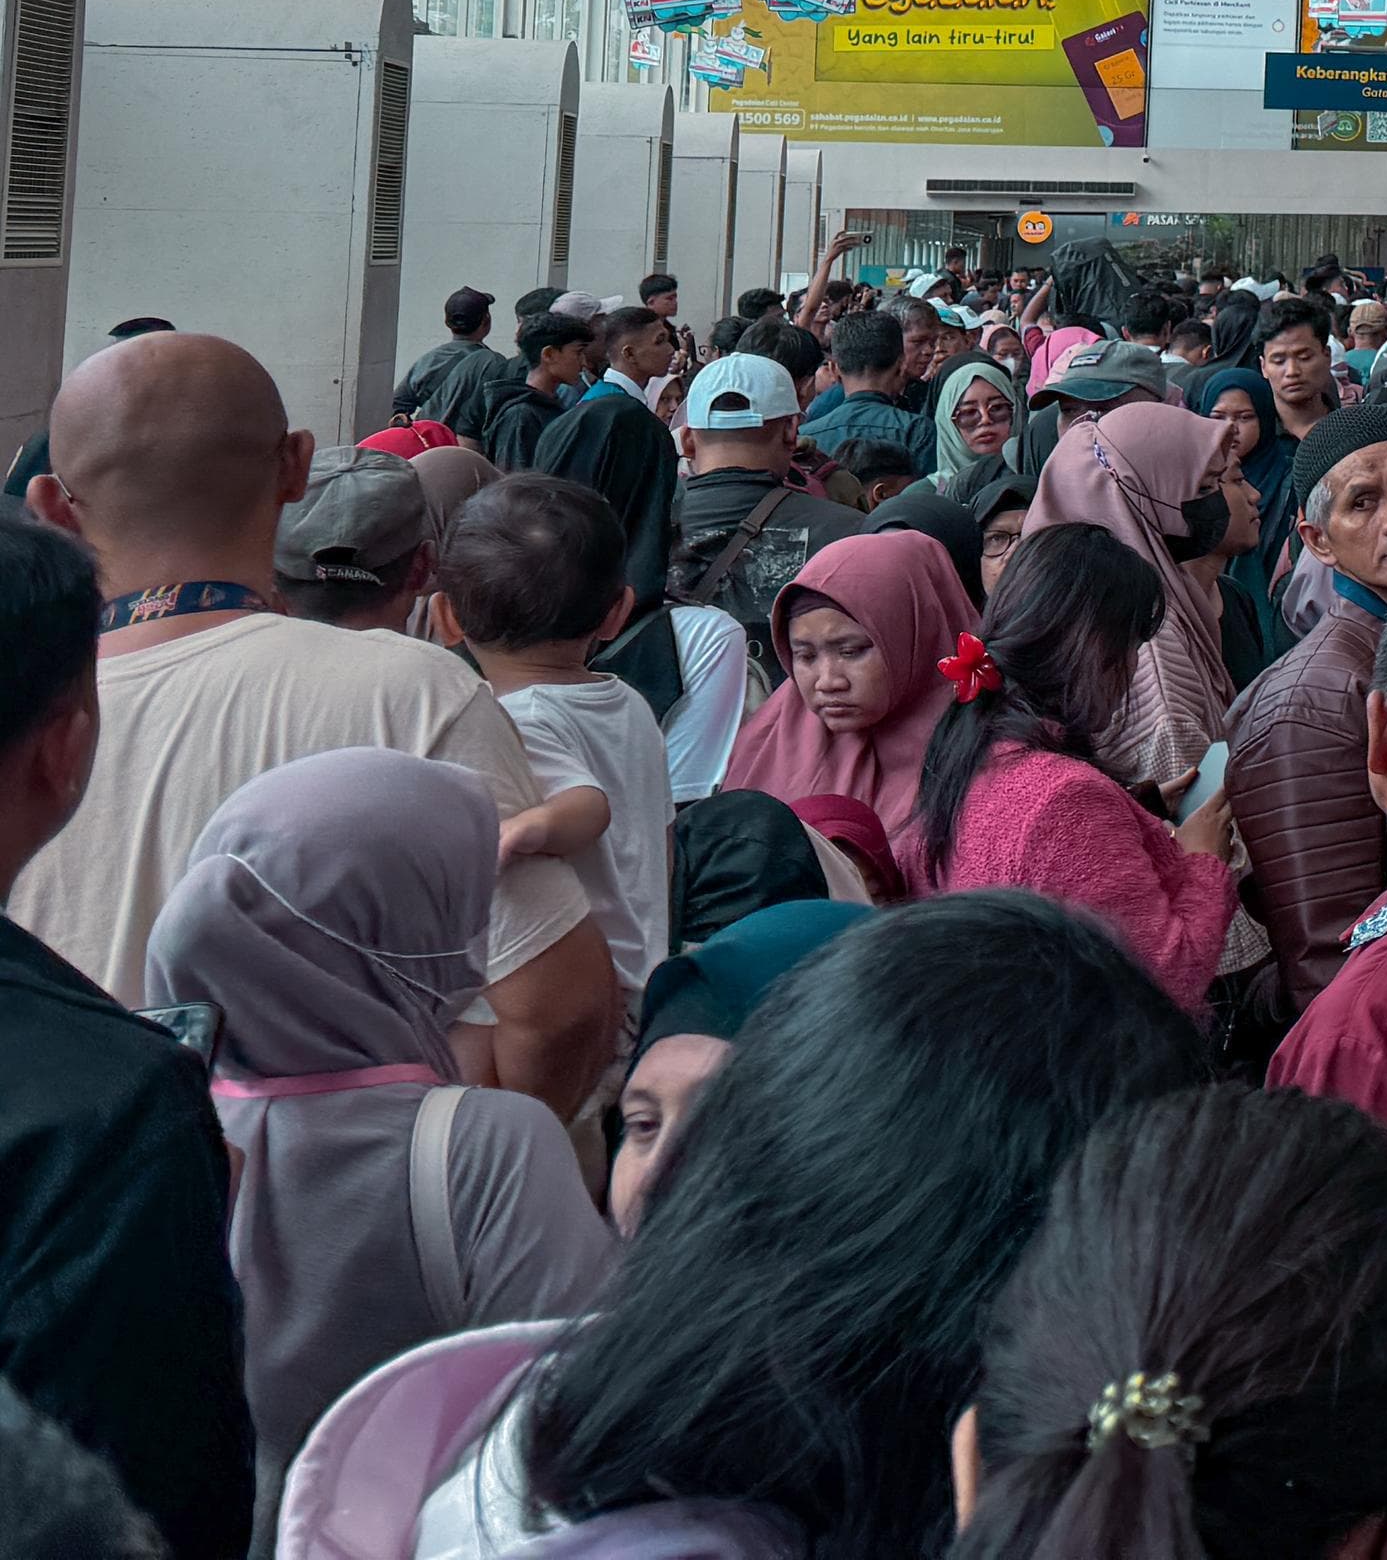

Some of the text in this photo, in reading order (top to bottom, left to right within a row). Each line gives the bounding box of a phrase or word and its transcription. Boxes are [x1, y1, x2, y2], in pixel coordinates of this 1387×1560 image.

[847, 28, 1035, 47] Yang lain tiru-tiru!
[740, 112, 801, 126] 1500 569
